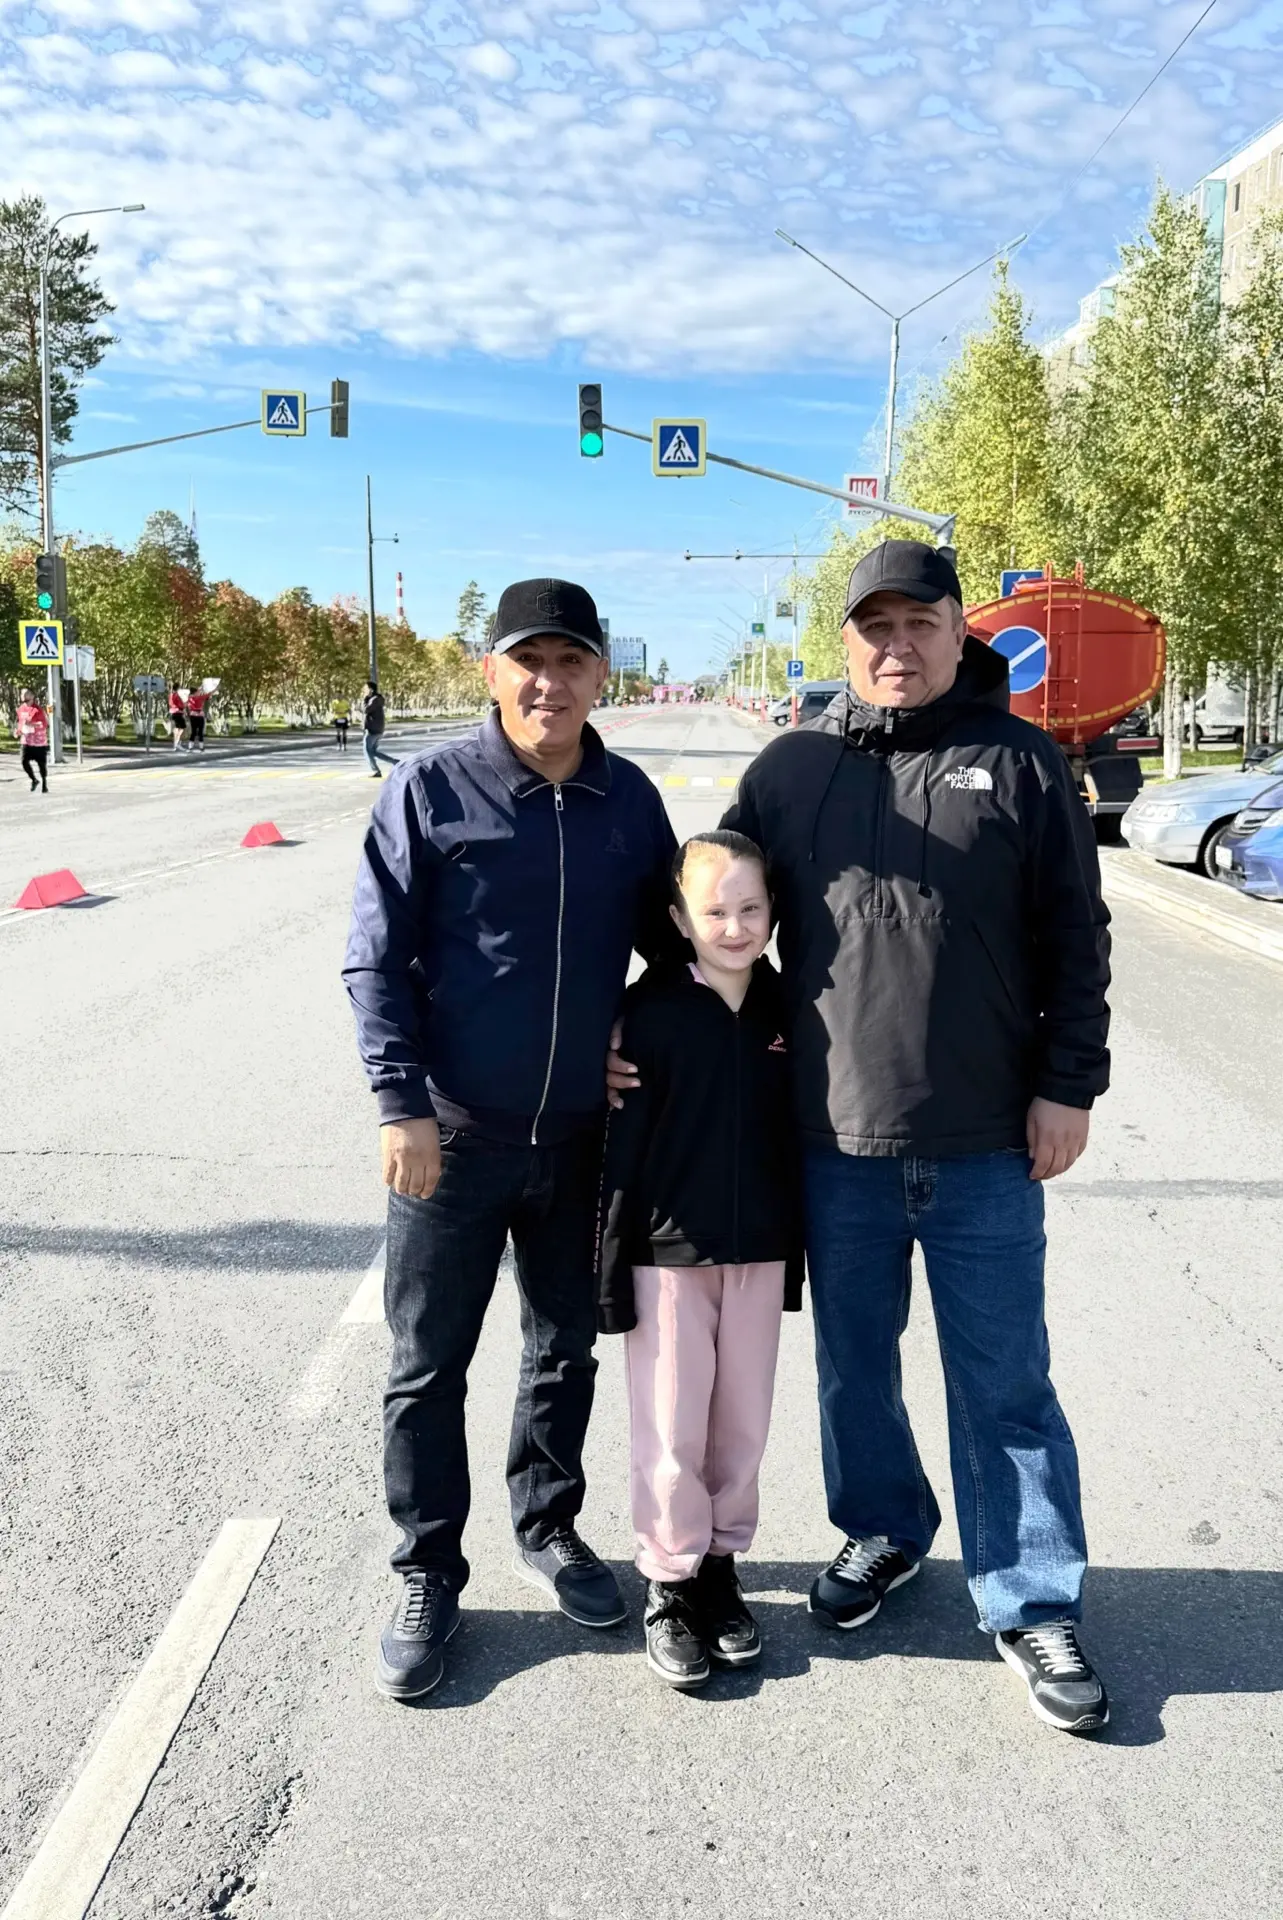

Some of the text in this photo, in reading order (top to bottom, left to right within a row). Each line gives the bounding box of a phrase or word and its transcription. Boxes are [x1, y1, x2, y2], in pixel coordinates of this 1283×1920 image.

[791, 662, 801, 676] P
[957, 766, 976, 775] THE
[945, 773, 976, 782] NORTH
[950, 781, 976, 789] FACE
